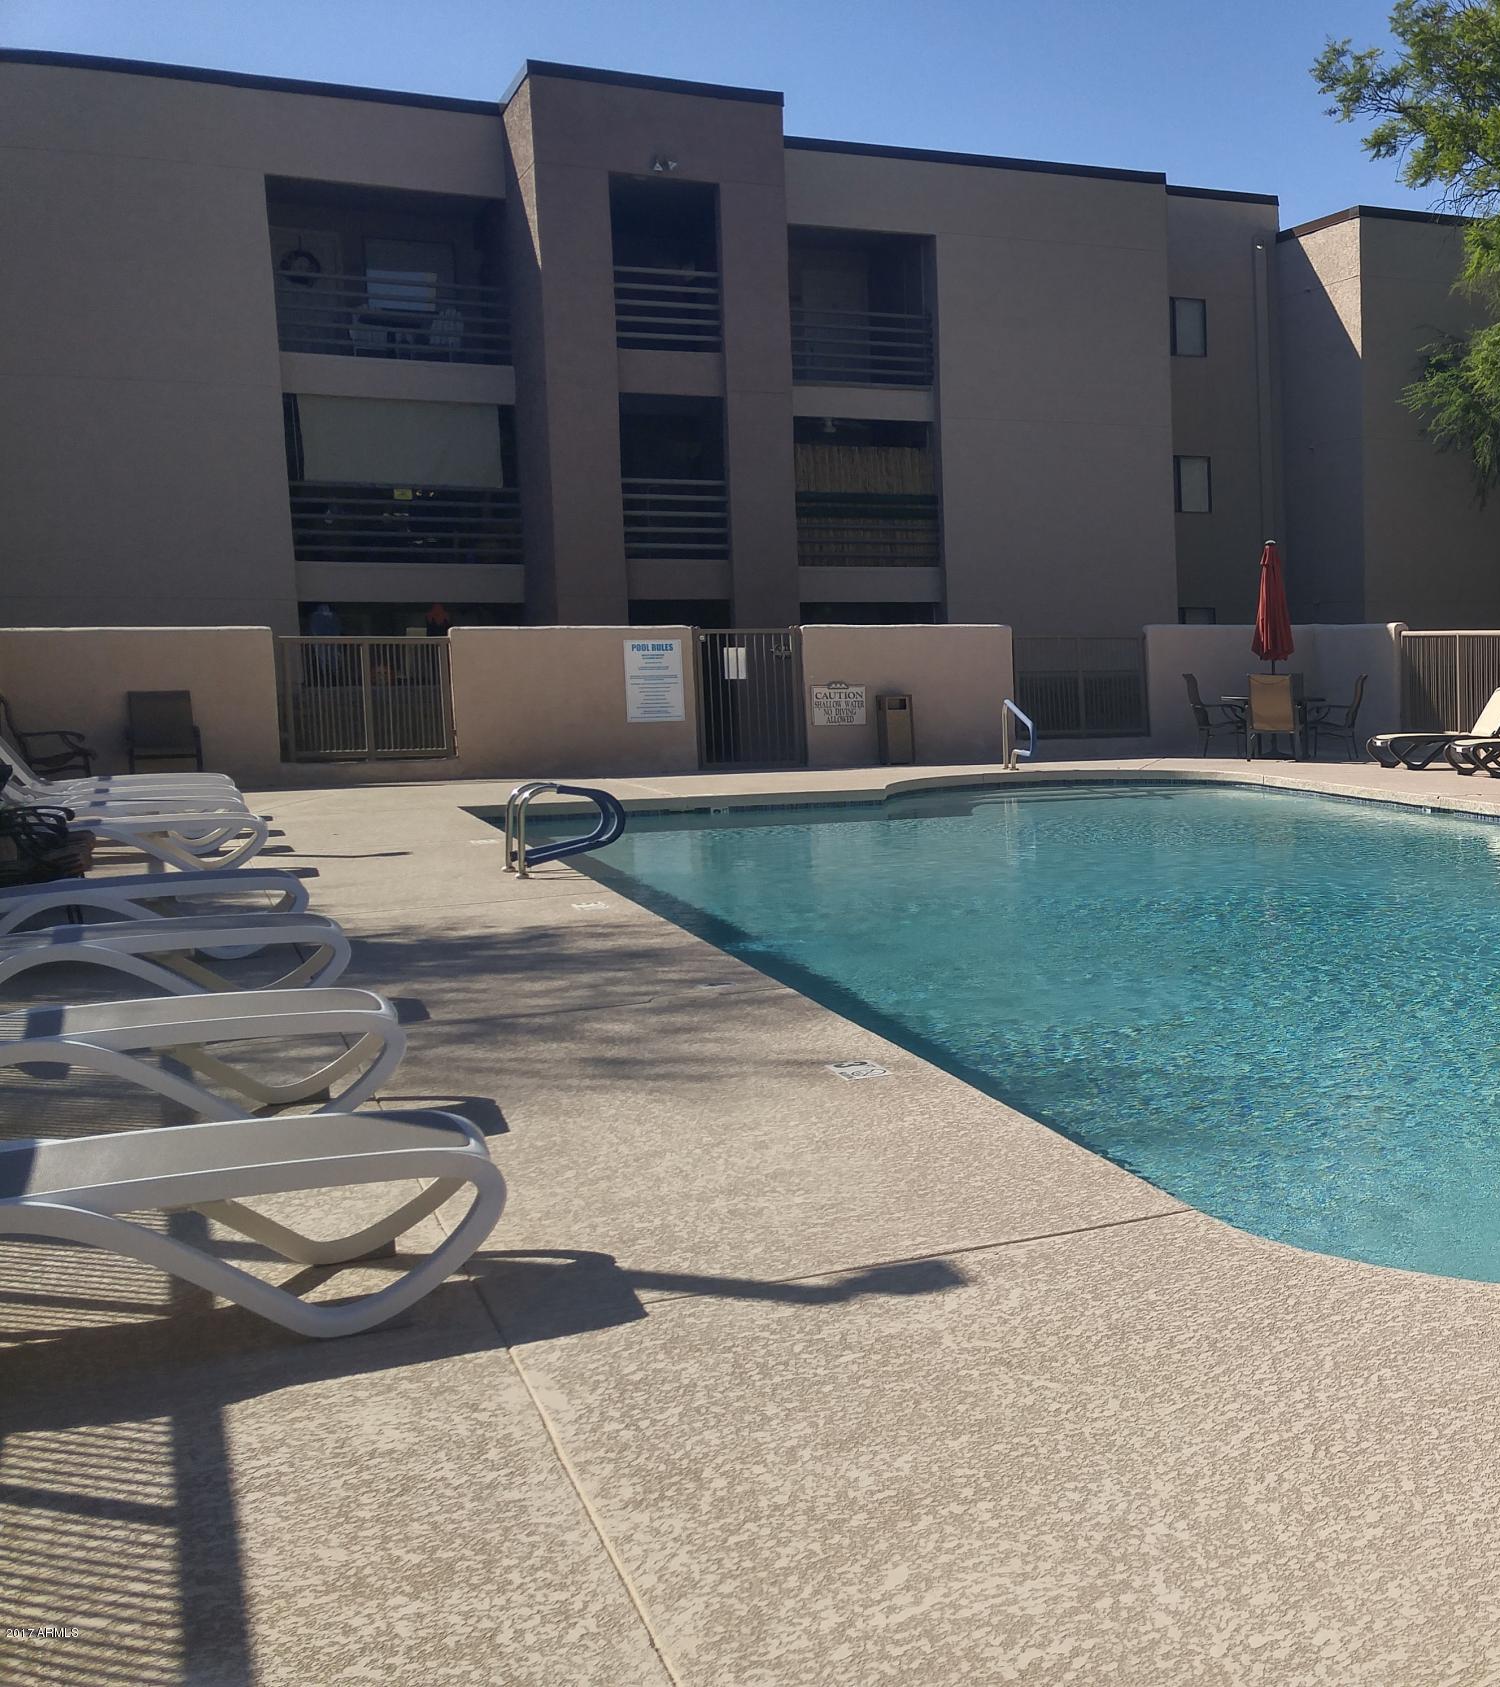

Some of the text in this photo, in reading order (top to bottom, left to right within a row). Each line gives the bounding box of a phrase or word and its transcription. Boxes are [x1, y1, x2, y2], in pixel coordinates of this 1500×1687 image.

[631, 643, 674, 651] POOL RULES
[815, 691, 864, 700] CAUTION
[814, 700, 865, 708] SHALLOW WATER
[823, 708, 857, 716] NO DIVING
[826, 716, 855, 724] ALLOWED
